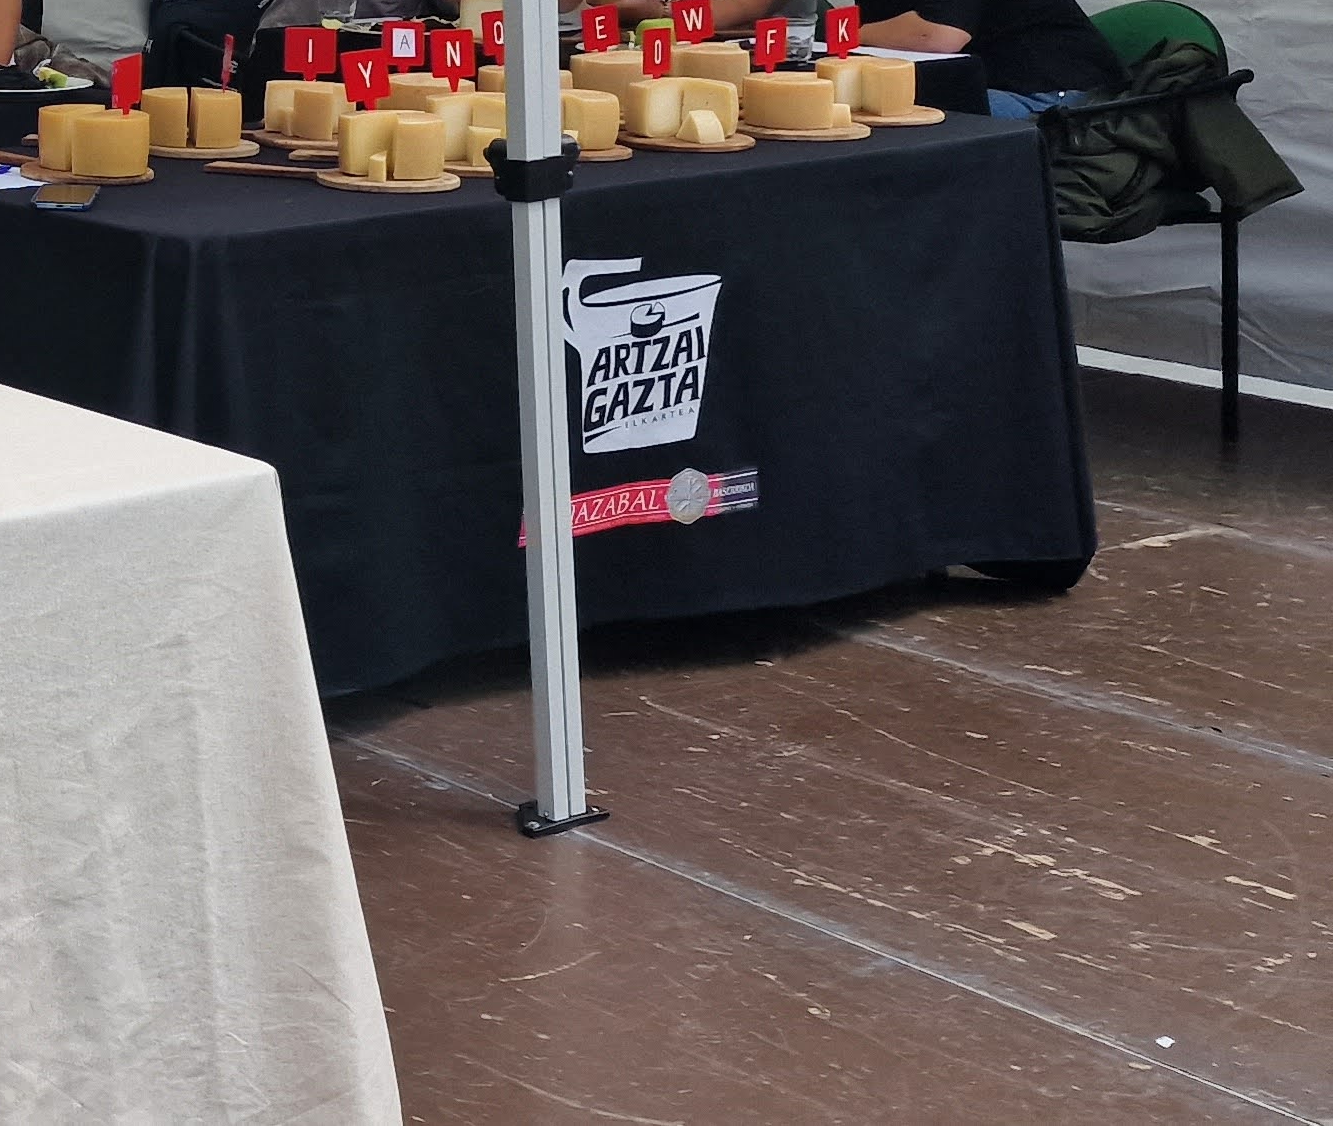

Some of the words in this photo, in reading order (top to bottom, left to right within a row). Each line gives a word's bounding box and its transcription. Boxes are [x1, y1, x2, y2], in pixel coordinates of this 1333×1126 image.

[493, 20, 504, 45] Q
[596, 15, 608, 40] E
[683, 7, 703, 32] W
[838, 17, 849, 43] K
[399, 33, 411, 51] A
[446, 40, 461, 68] N
[766, 29, 777, 55] F
[358, 60, 373, 89] Y
[586, 325, 706, 389] ARTZAI
[583, 364, 700, 433] GAZTA
[625, 406, 695, 429] ELKARTEA
